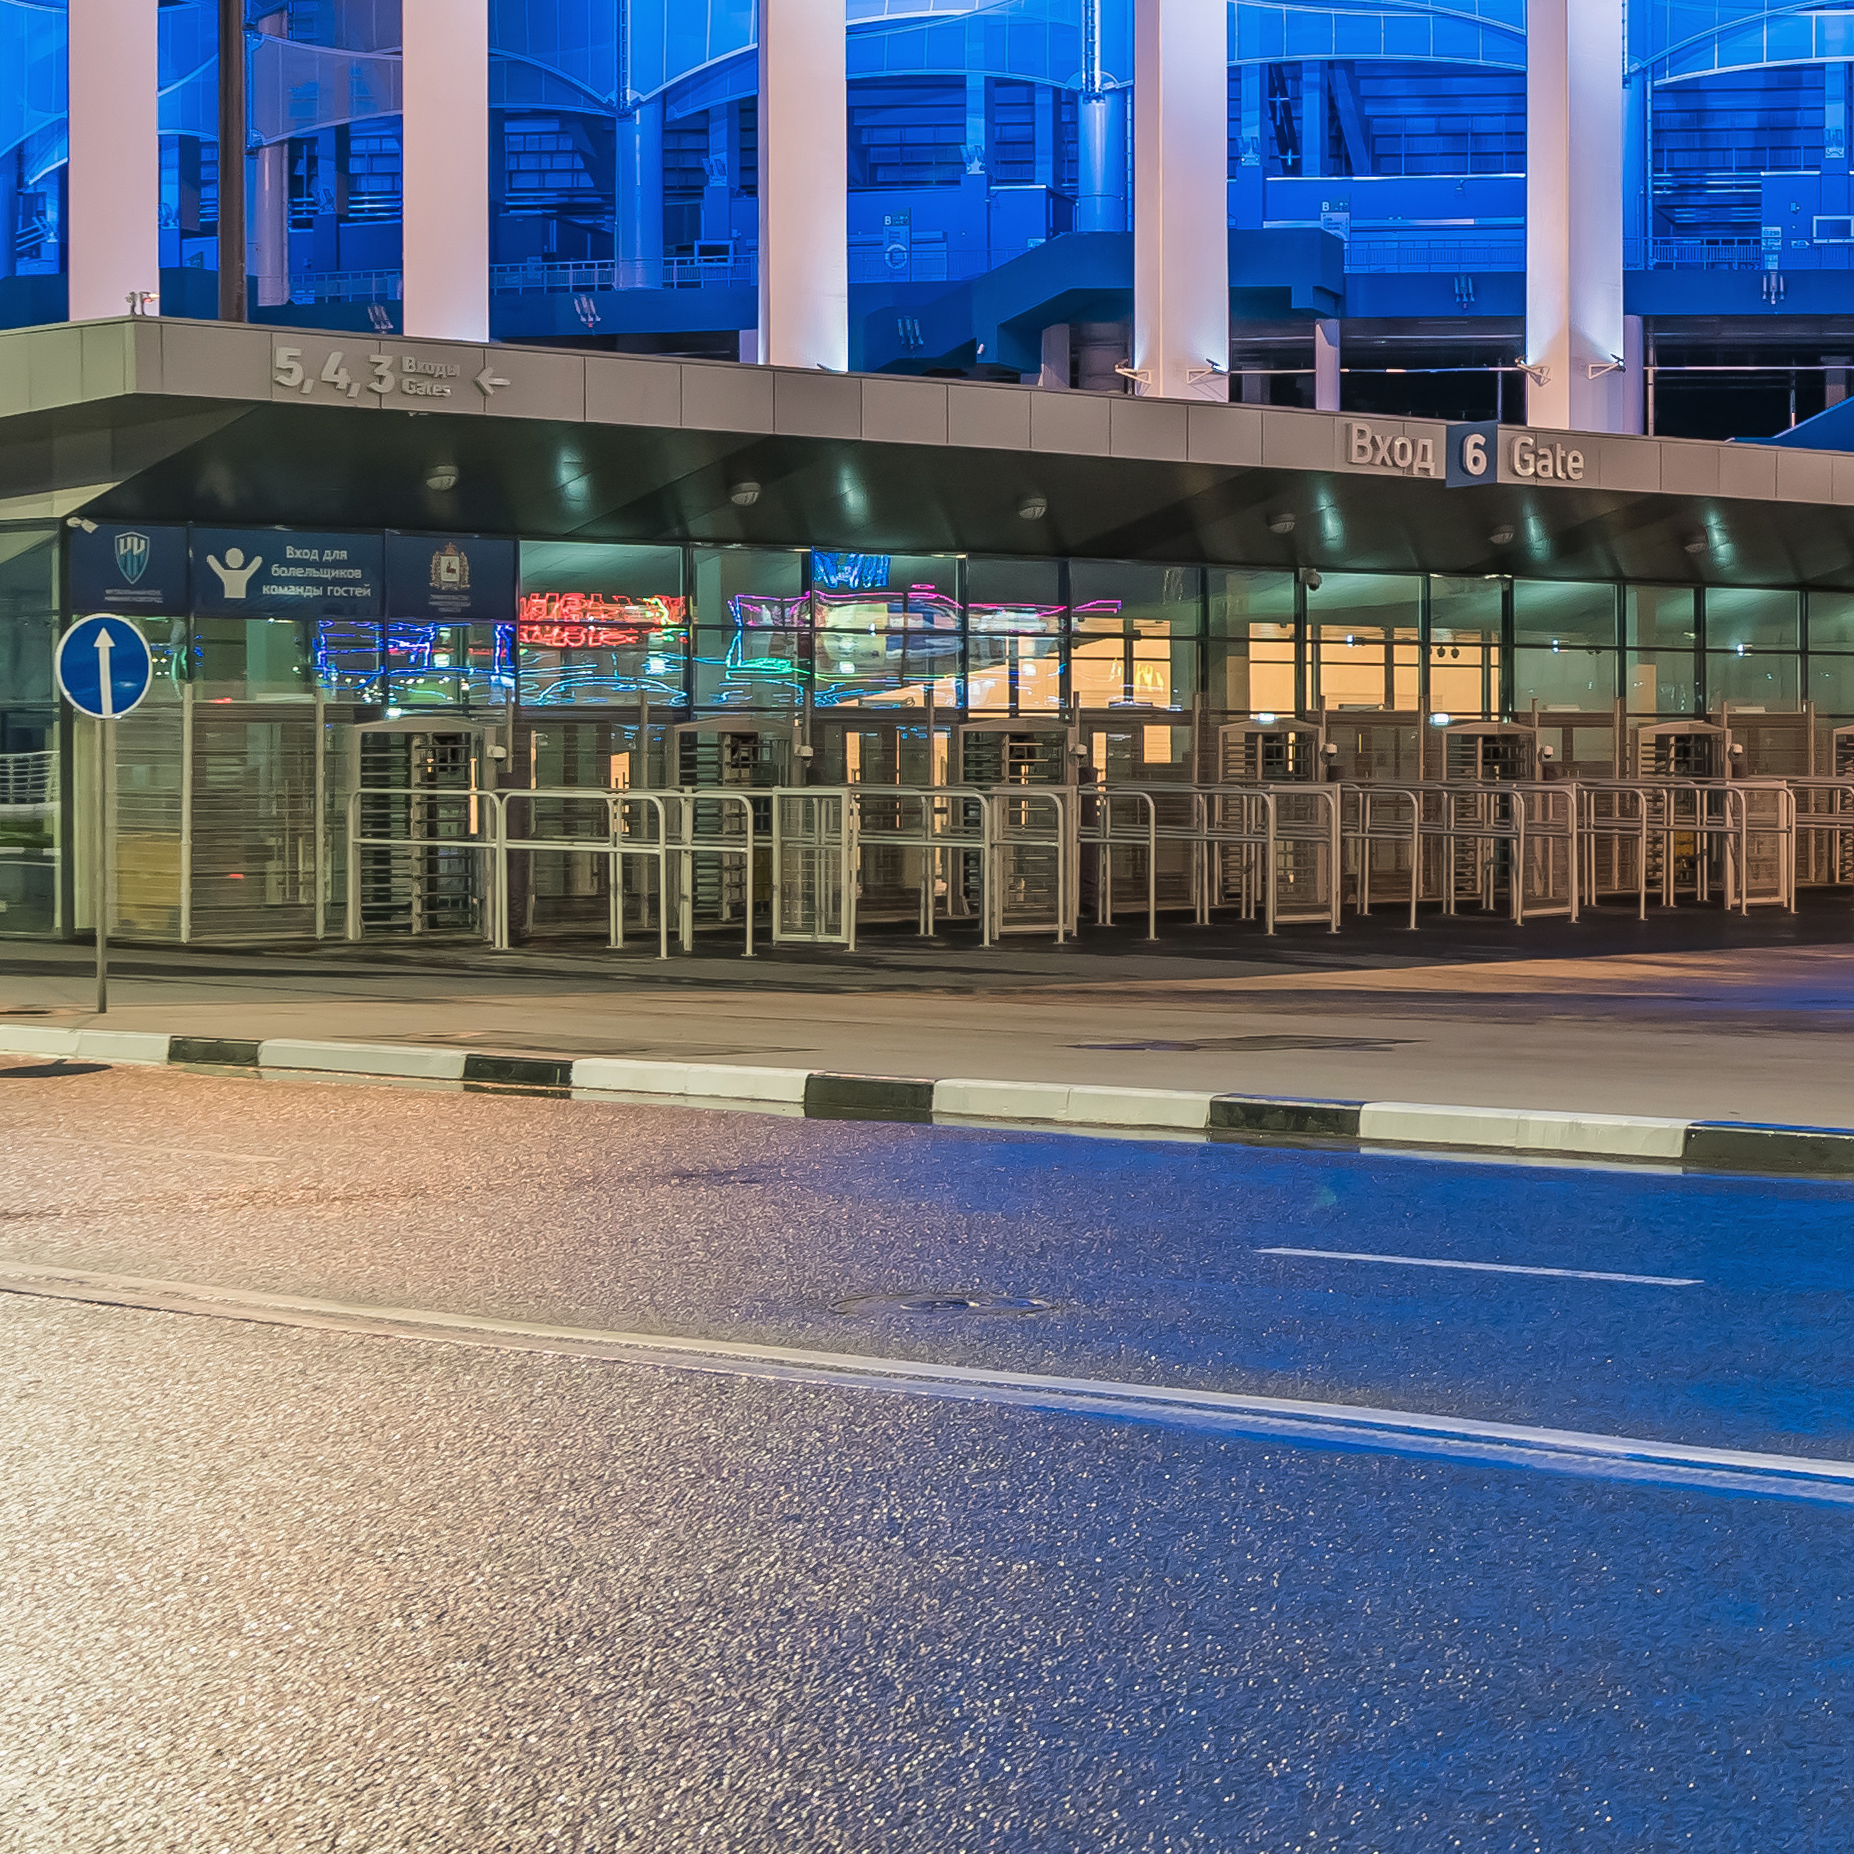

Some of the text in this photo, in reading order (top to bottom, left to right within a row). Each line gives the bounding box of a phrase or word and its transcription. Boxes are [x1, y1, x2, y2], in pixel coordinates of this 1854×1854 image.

[1346, 423, 1585, 481] Вход 6 Gate
[285, 546, 348, 562] Вход для
[271, 563, 362, 581] болельщиков
[262, 583, 372, 598] команды гостей
